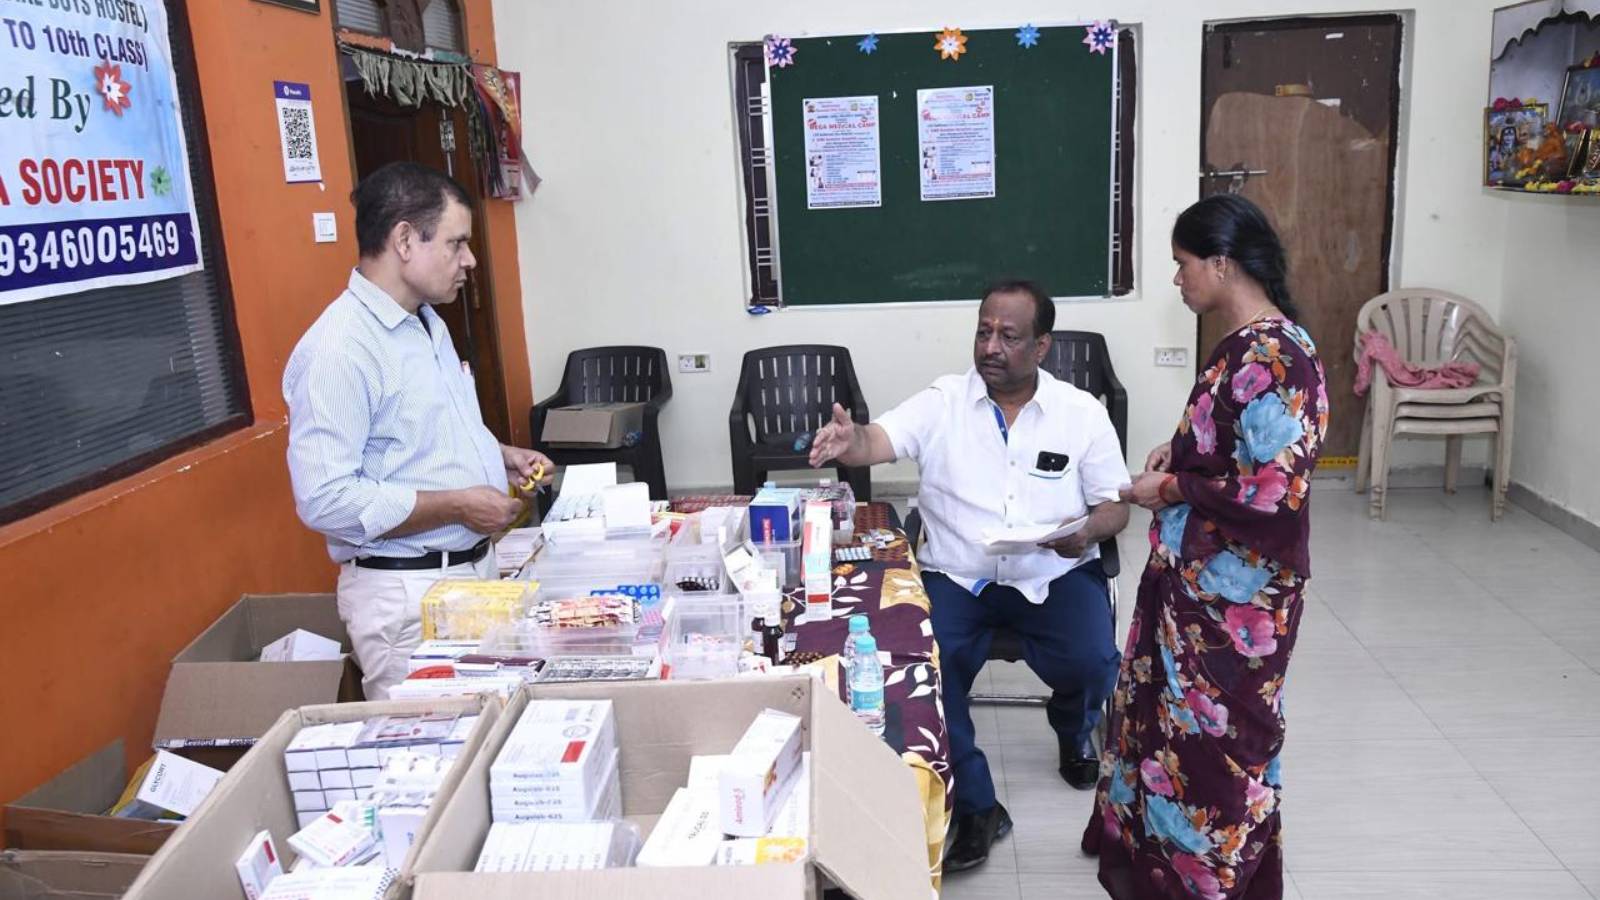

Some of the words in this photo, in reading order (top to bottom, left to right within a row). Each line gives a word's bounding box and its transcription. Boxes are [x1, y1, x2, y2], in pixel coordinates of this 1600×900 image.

[96, 0, 148, 33] HOSTEL)
[3, 18, 36, 50] TO
[42, 25, 90, 57] 10th
[94, 33, 149, 72] CLASS)
[49, 78, 91, 133] By
[19, 158, 145, 206] SOCIETY
[0, 220, 180, 277] 9346005469
